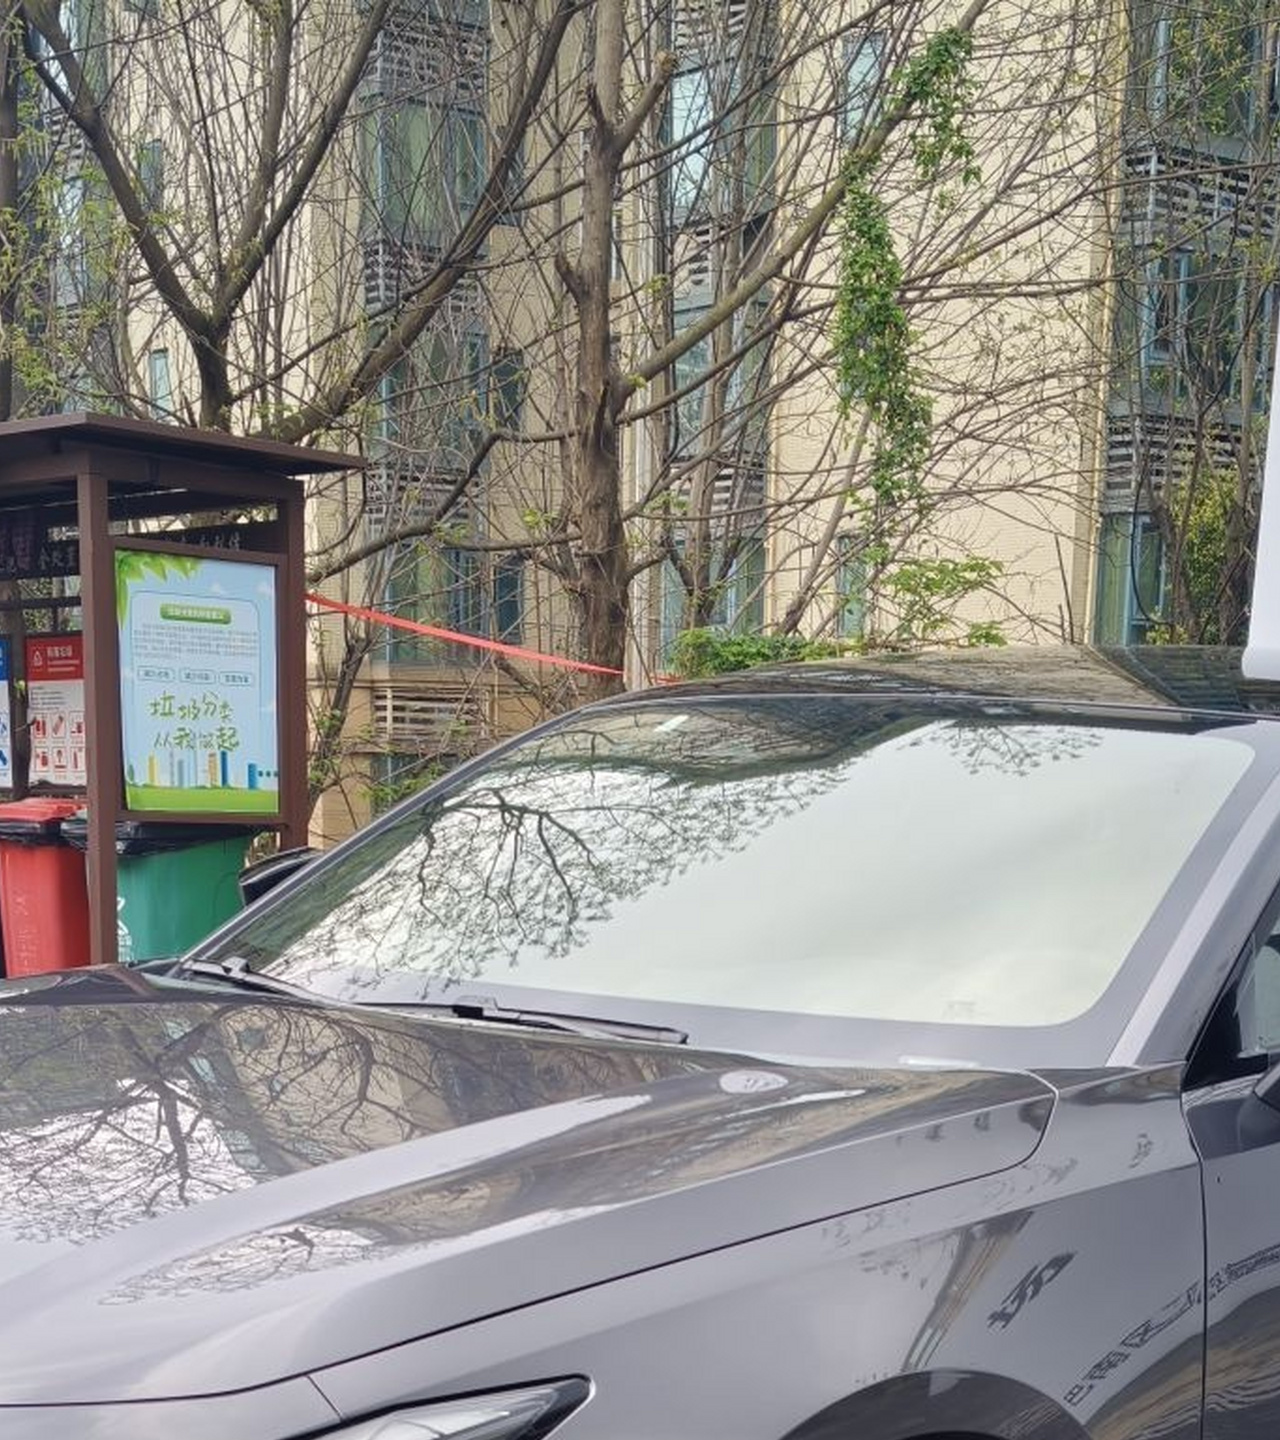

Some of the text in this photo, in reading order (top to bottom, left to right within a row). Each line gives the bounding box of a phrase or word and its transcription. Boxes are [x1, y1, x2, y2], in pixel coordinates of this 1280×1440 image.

[149, 690, 234, 722] 垃圾分类
[154, 726, 240, 752] 从我做起
